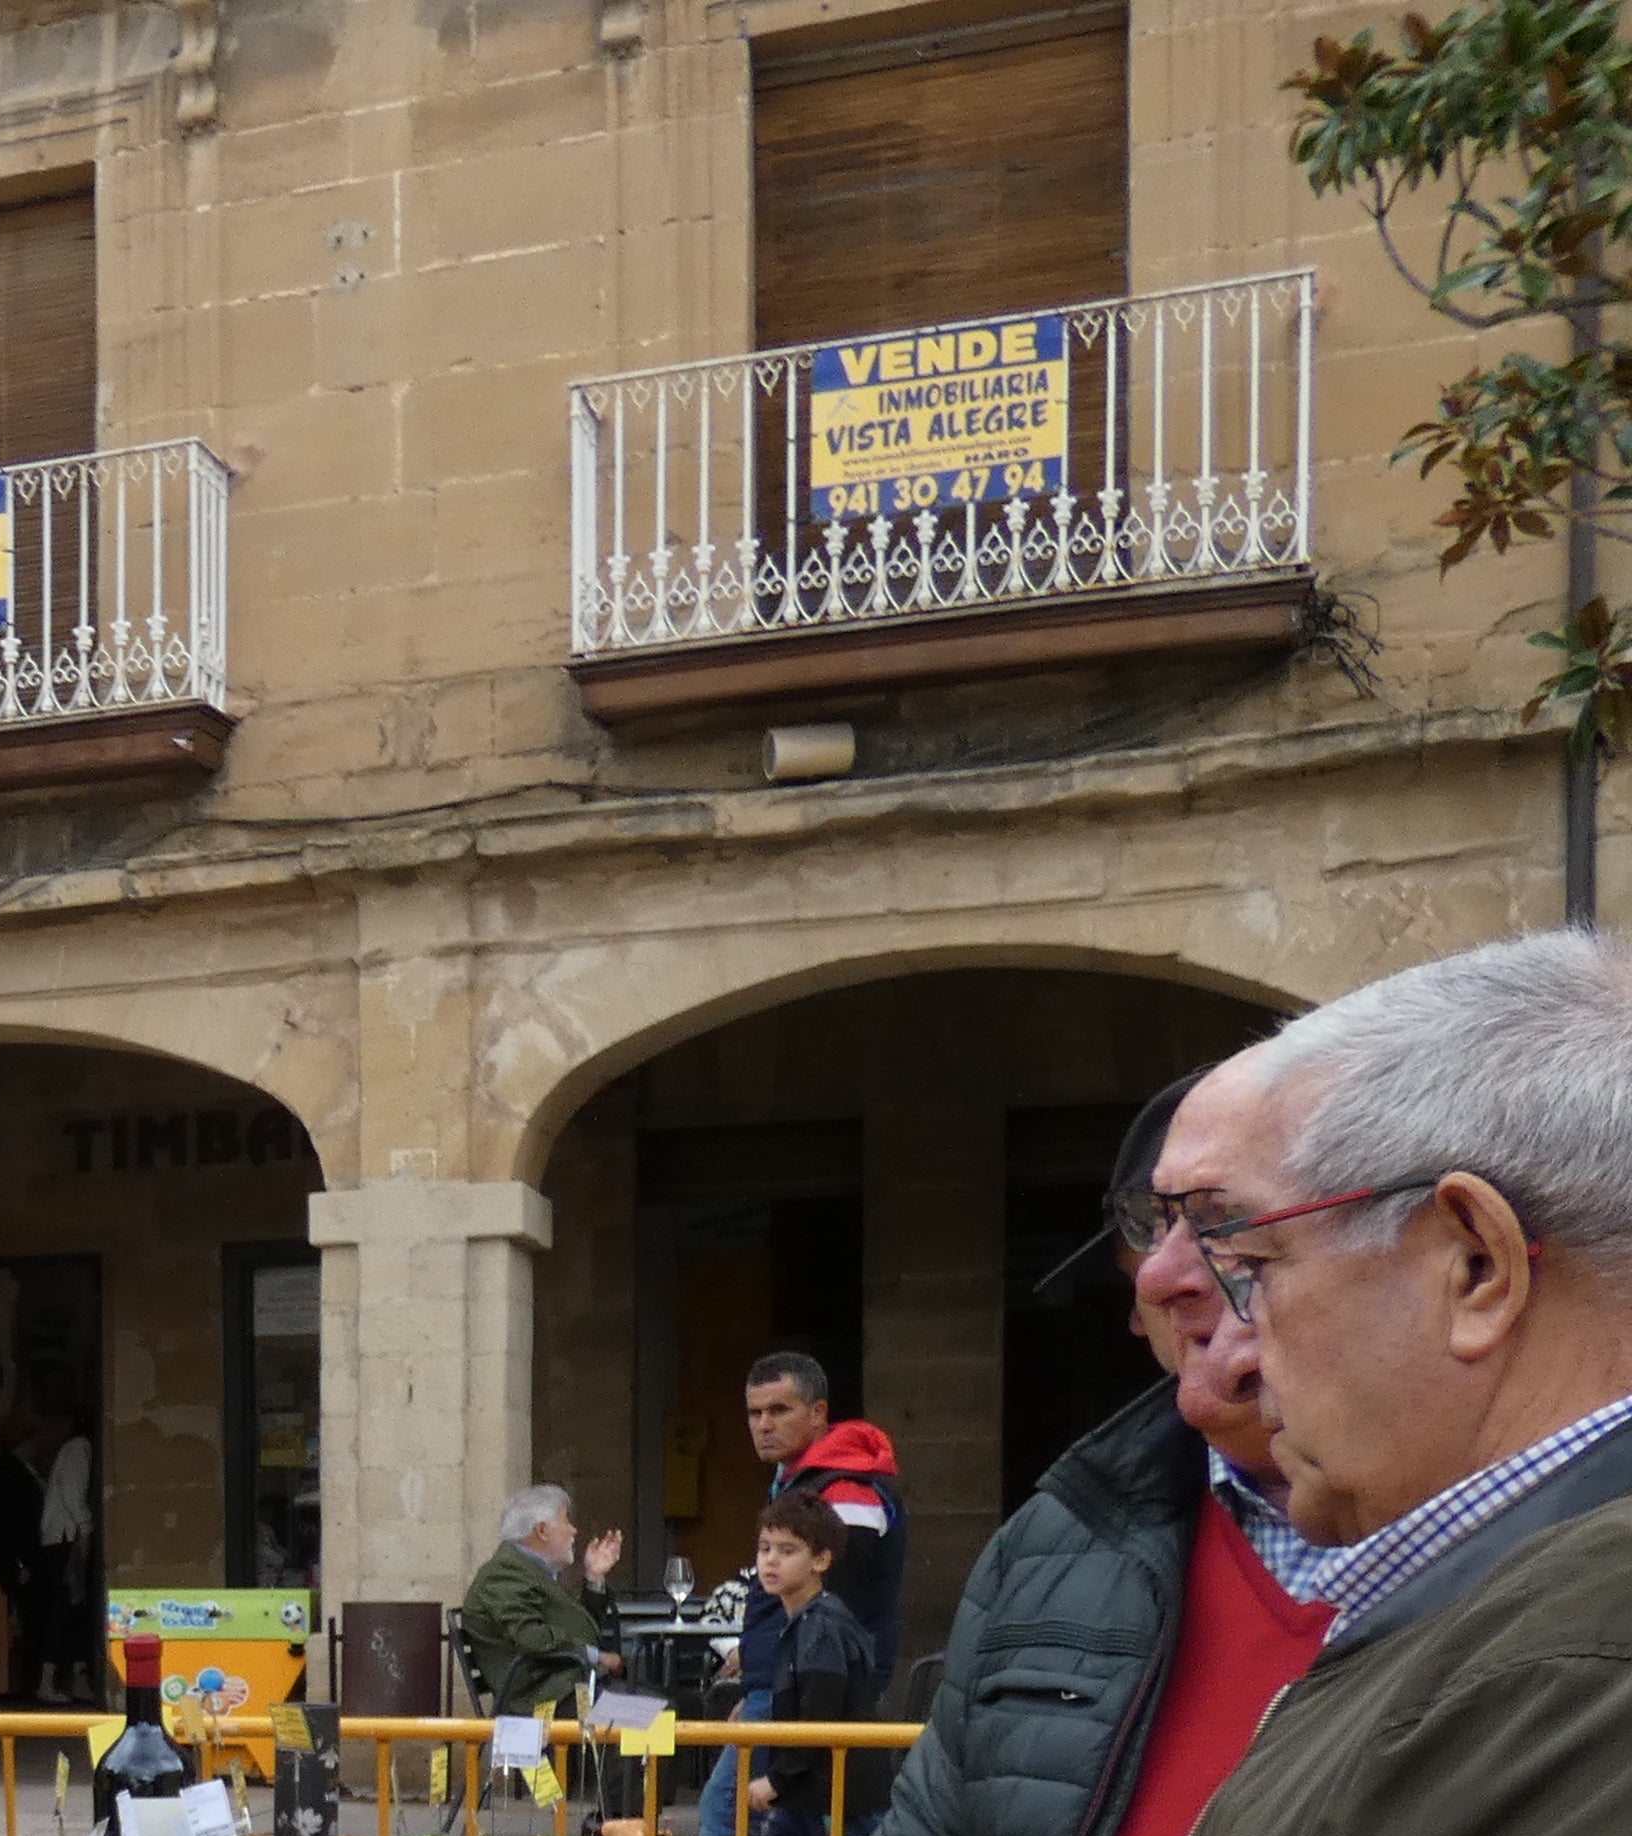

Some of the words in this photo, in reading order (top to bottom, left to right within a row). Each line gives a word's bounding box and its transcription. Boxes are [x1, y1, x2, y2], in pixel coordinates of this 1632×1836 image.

[839, 322, 1037, 386] VENDE
[878, 368, 1049, 415] INMOBILIARIA
[826, 417, 912, 456] VISTA
[928, 398, 1048, 441] ALEGRE
[829, 482, 880, 517] 941
[894, 474, 938, 510] 30
[951, 467, 990, 502] 47
[1004, 461, 1045, 496] 94
